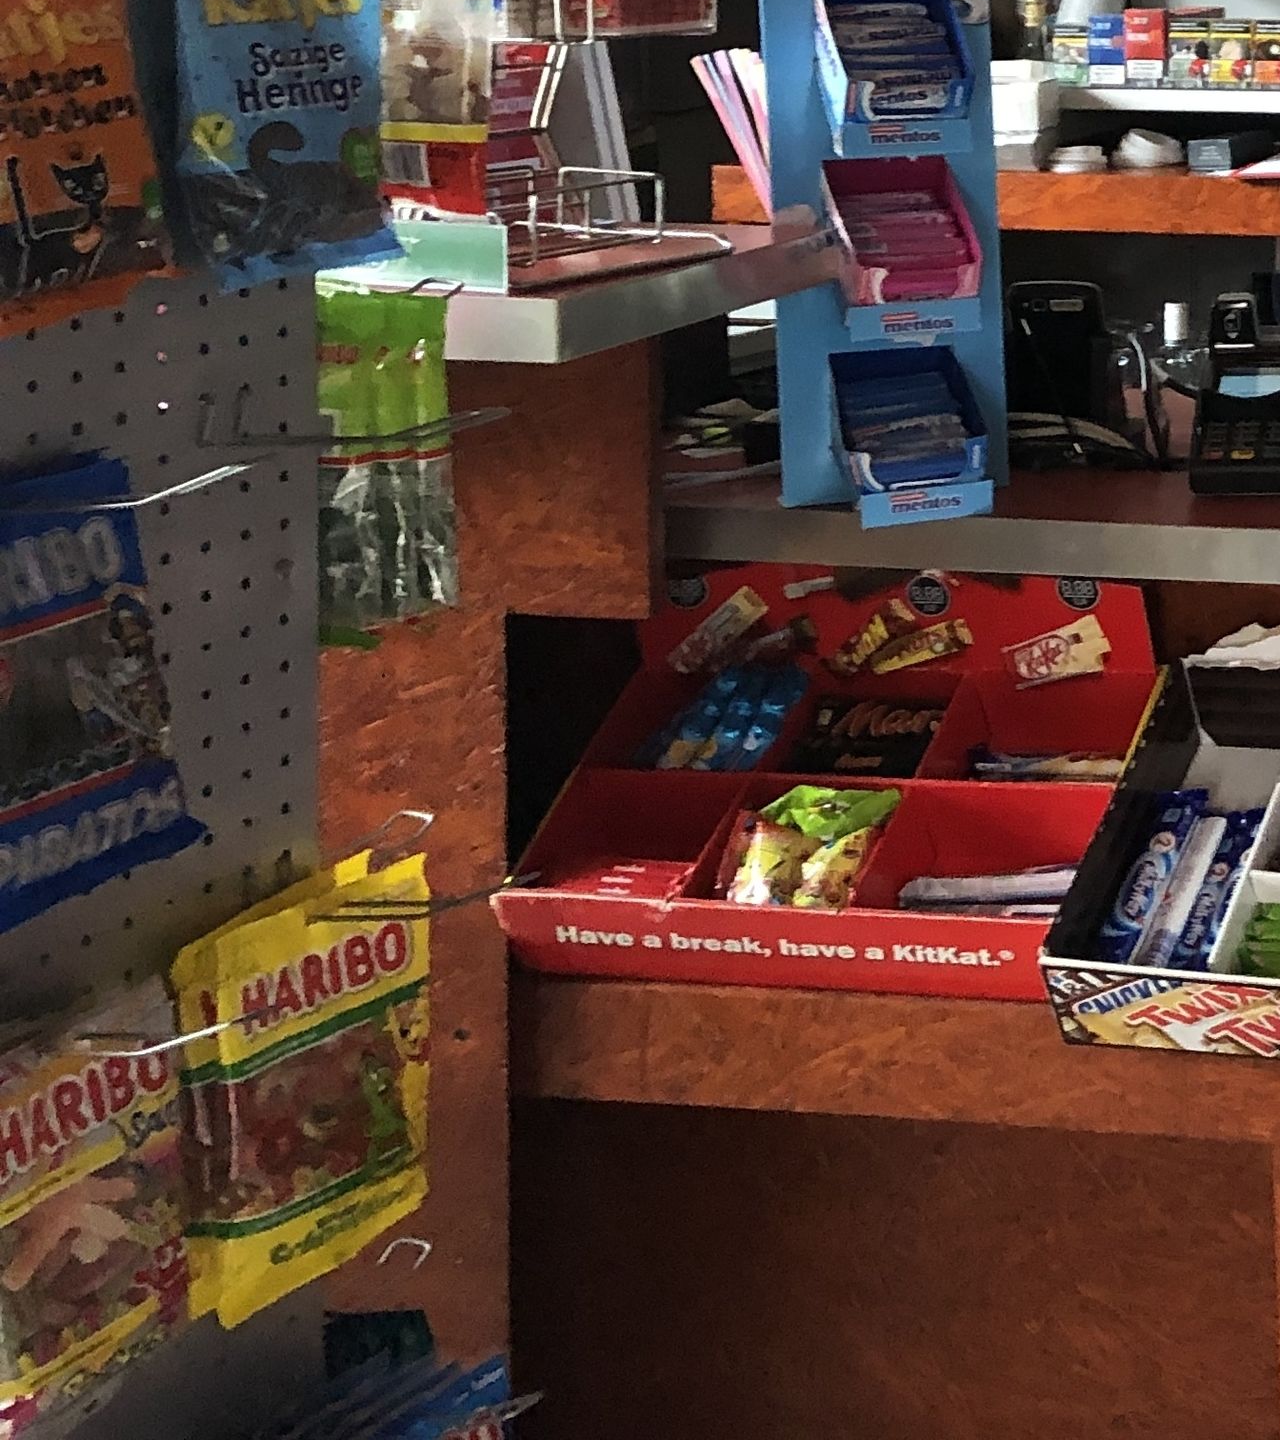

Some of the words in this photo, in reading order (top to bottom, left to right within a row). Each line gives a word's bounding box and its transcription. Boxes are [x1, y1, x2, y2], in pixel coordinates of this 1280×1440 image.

[234, 71, 364, 114] Heringe
[240, 920, 410, 1035] HARIBO
[555, 924, 634, 950] Have
[643, 931, 663, 951] a
[670, 932, 773, 961] break,
[778, 937, 856, 962] have
[866, 944, 885, 962] a
[0, 1038, 172, 1180] HARIBO
